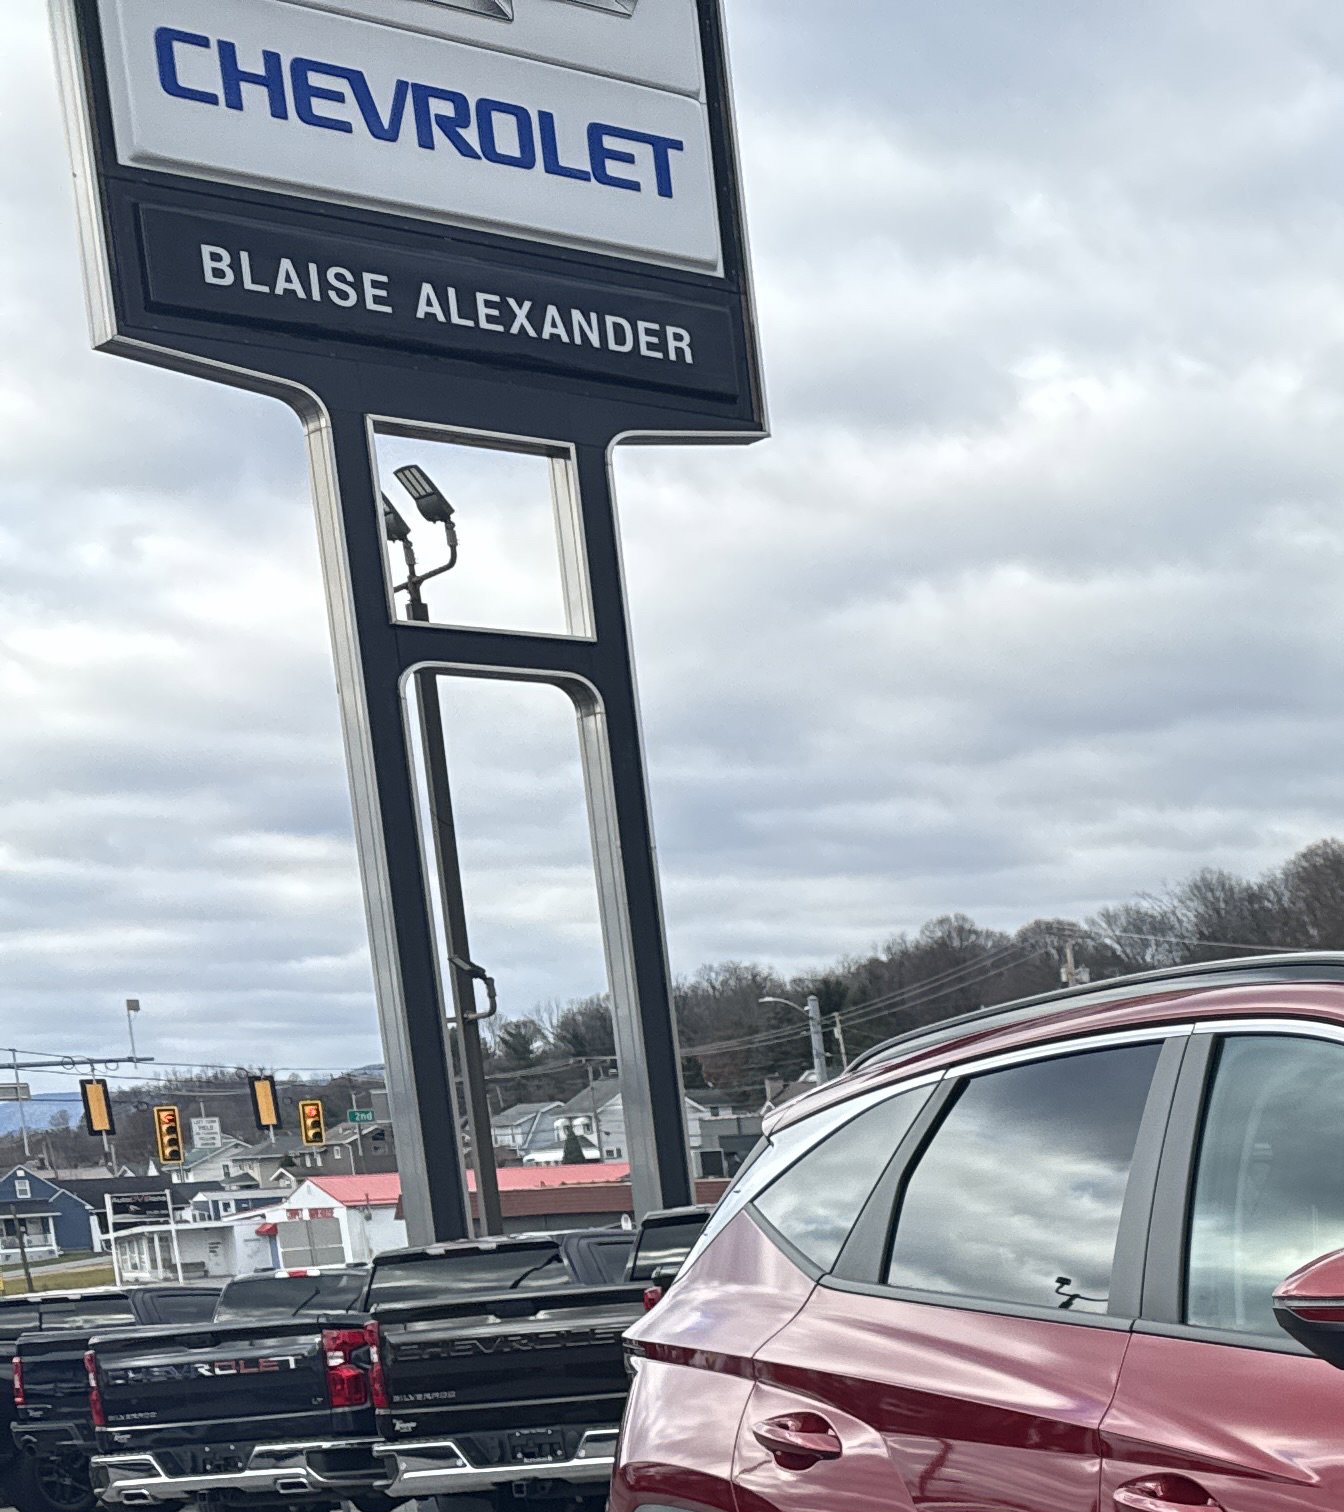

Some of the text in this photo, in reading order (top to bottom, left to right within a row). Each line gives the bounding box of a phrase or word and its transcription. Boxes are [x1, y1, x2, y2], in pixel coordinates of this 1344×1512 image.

[155, 26, 684, 199] CHEVROLET
[200, 243, 694, 364] BLAISE ALEXANDER
[354, 1111, 372, 1121] 2nd
[397, 1328, 625, 1361] CHEVROLE
[107, 1355, 302, 1386] CHEVROLET
